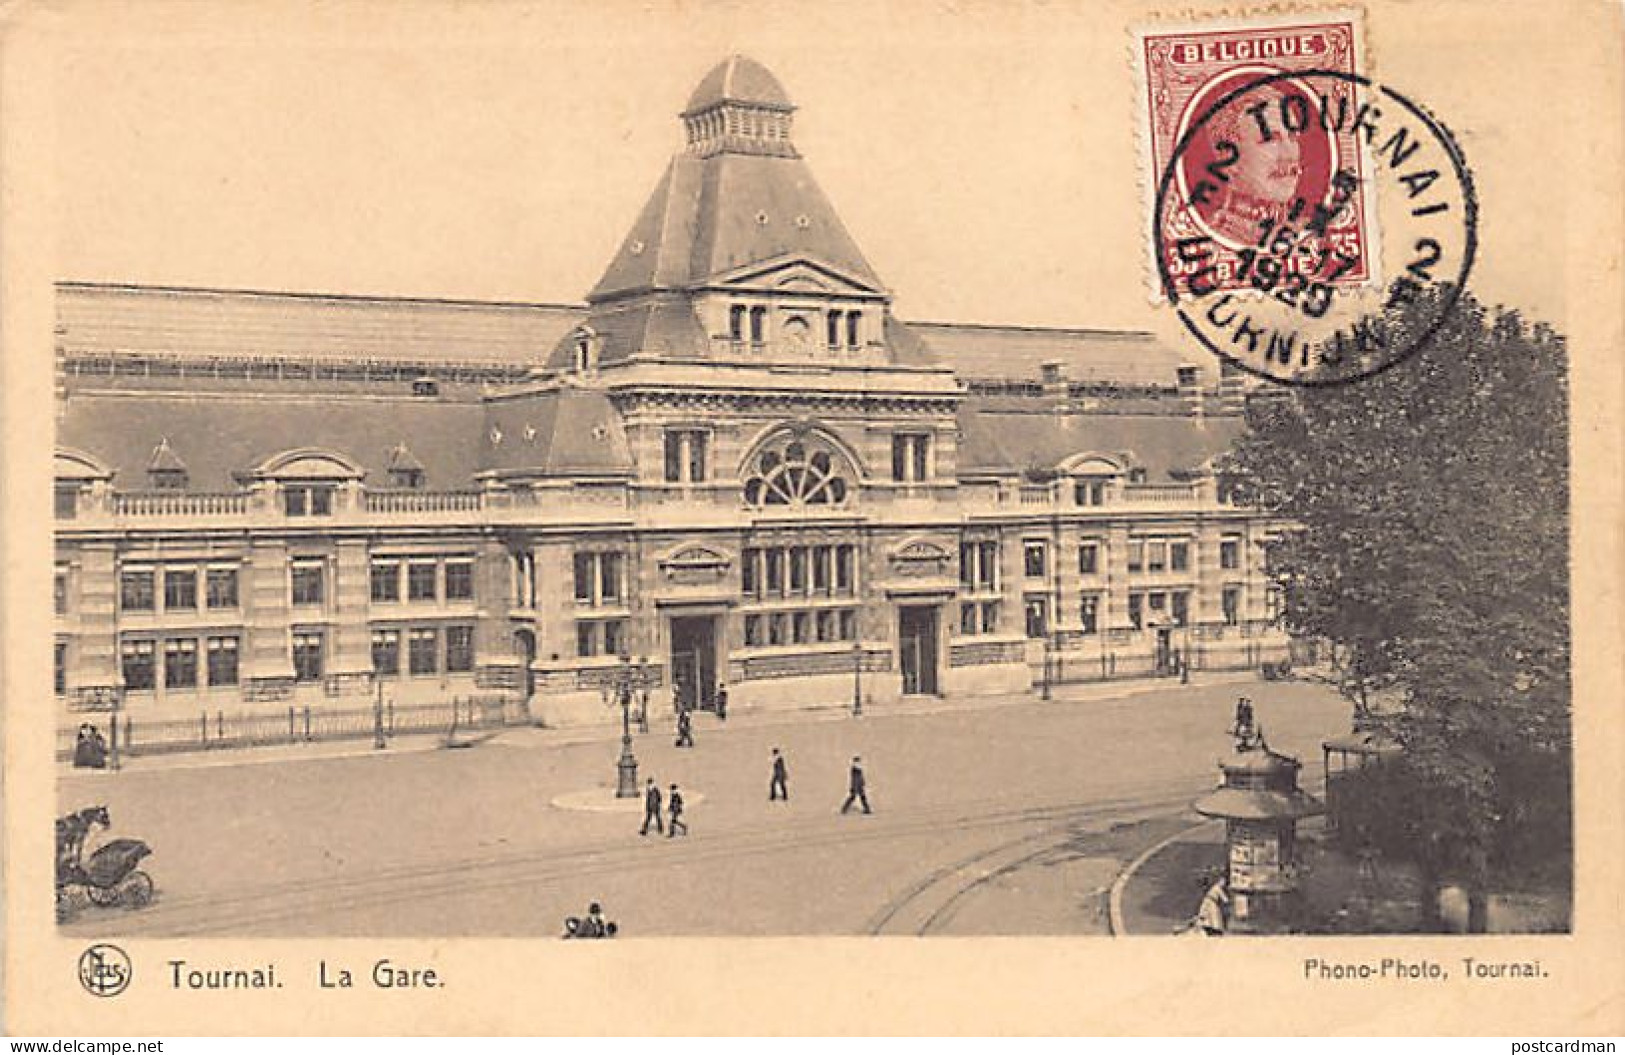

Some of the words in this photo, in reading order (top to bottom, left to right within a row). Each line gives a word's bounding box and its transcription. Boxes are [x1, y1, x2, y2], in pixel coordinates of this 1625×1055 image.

[1184, 35, 1314, 63] BELGIQUE
[1246, 95, 1449, 216] TOURNAI
[168, 960, 283, 988] Tournai.
[319, 960, 353, 988] La
[372, 958, 446, 988] Gare.
[1304, 958, 1449, 982] Phono-Photo,
[1462, 957, 1550, 978] Tournai.
